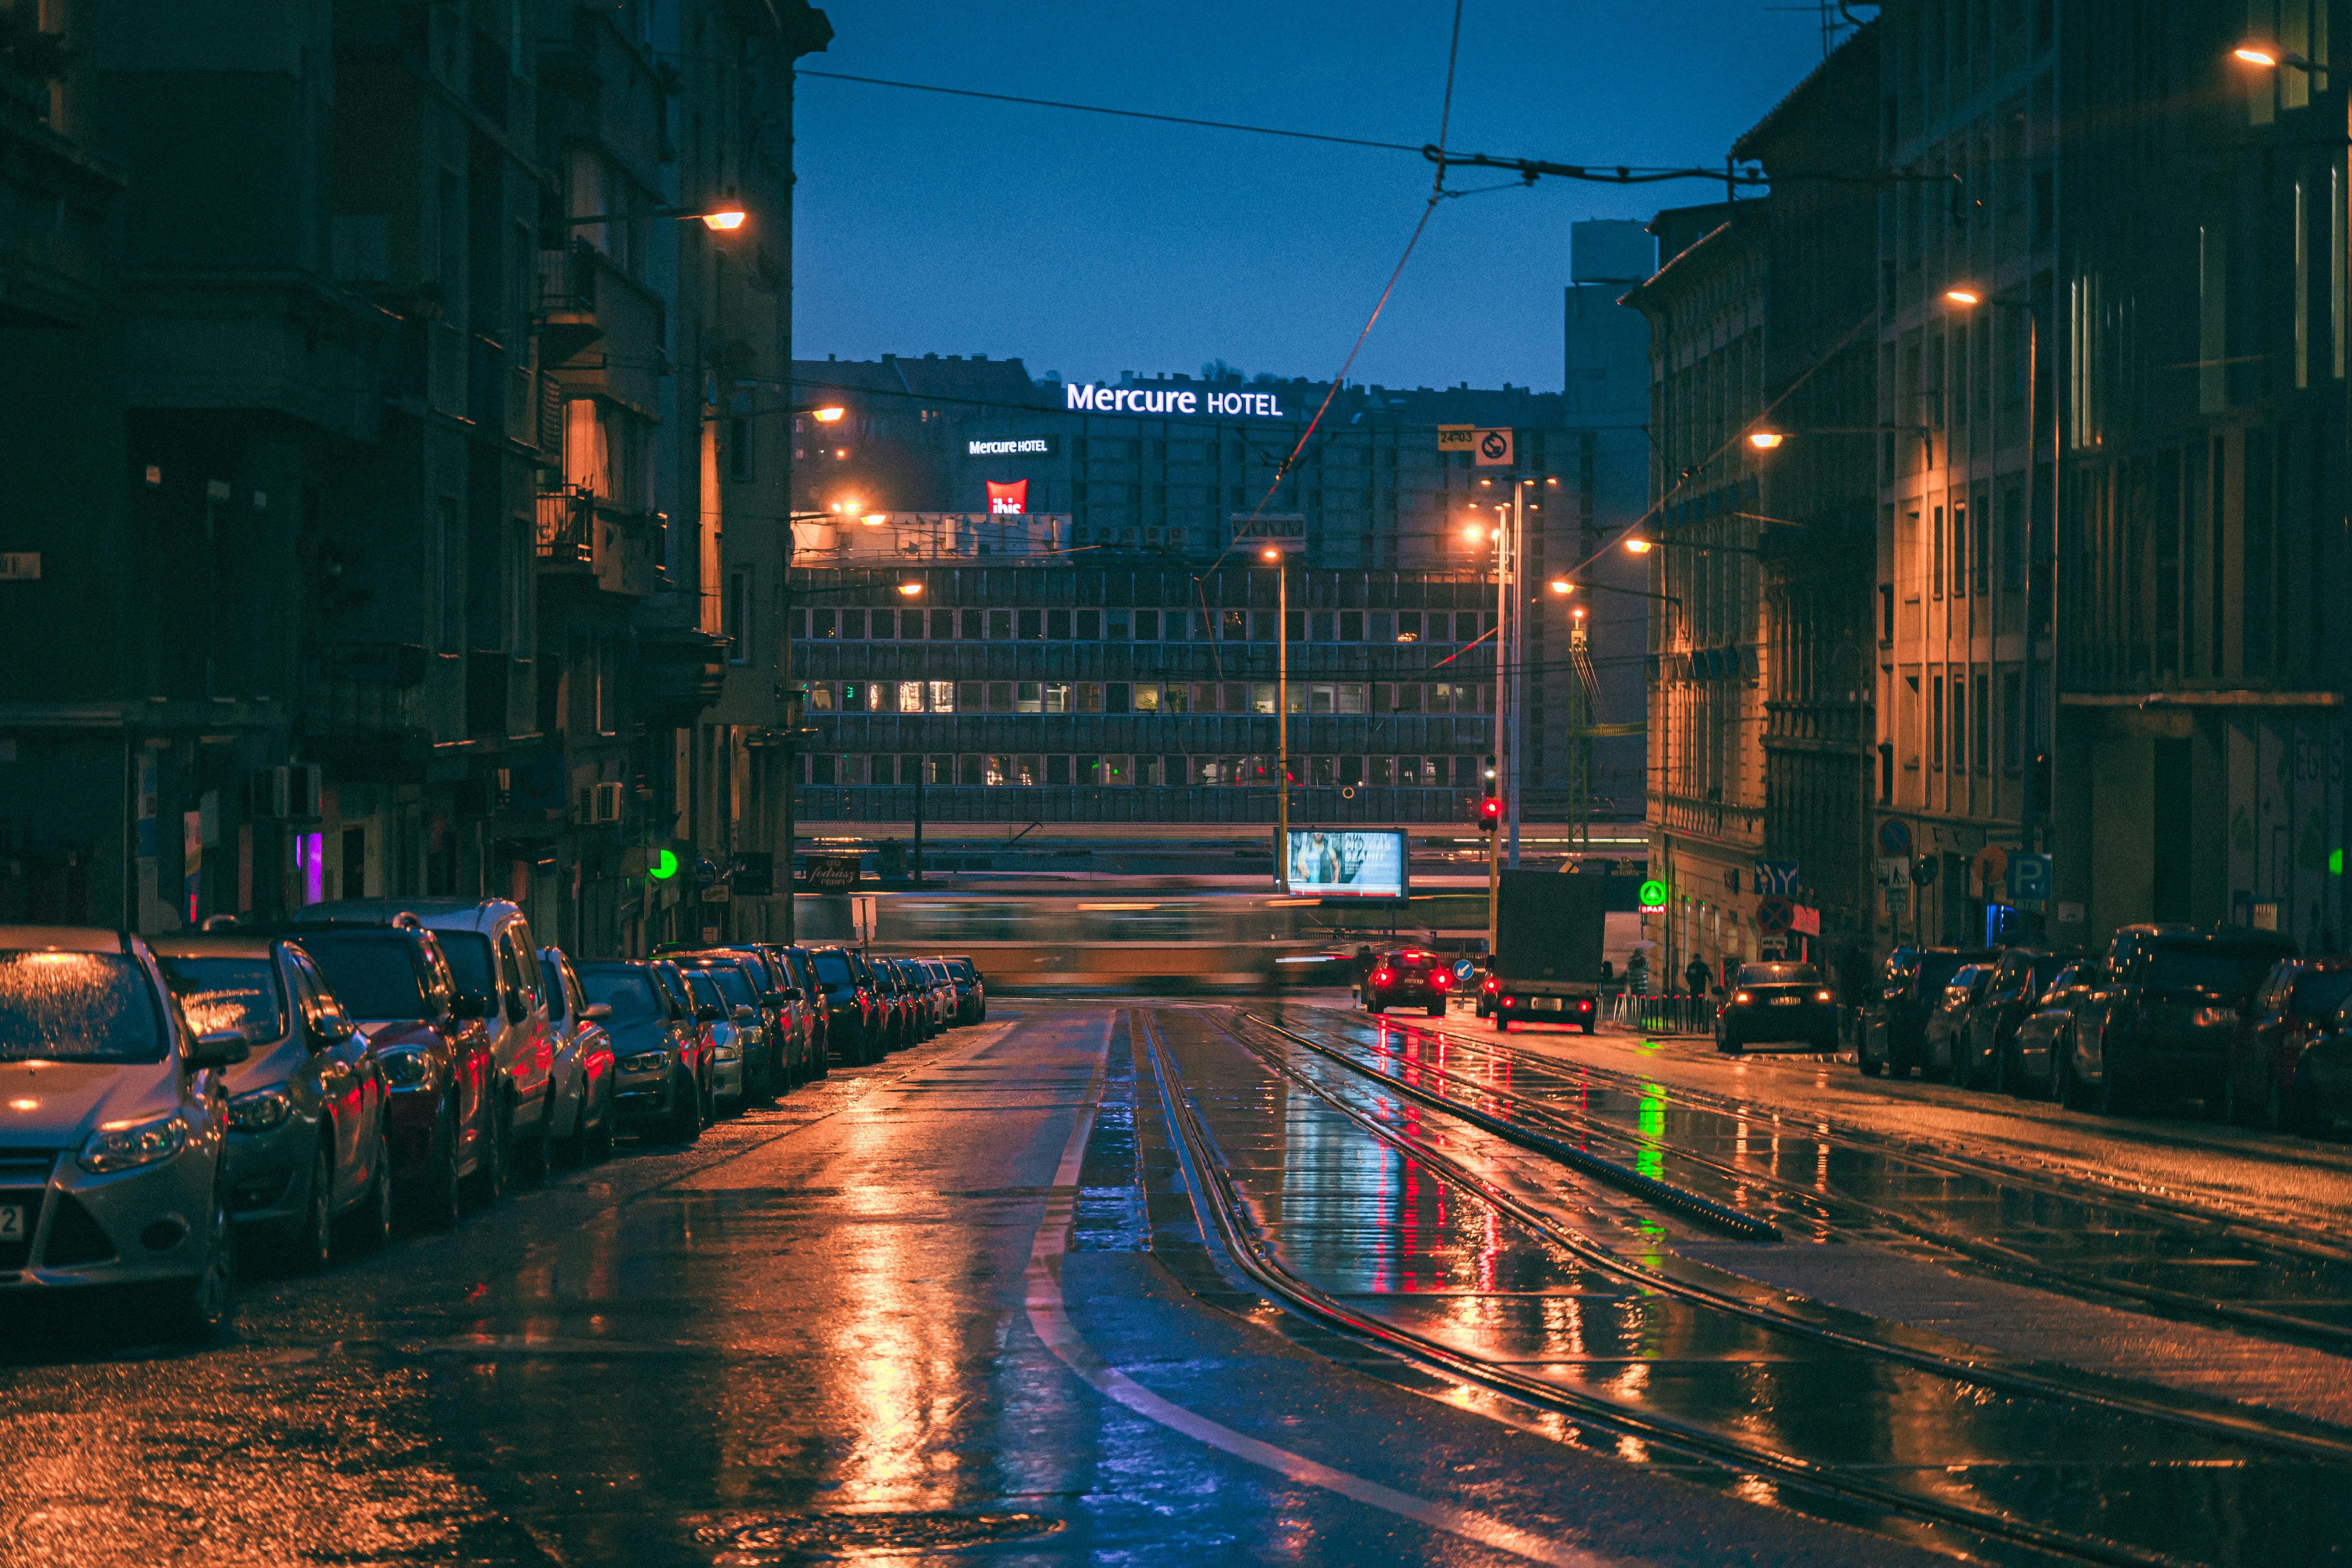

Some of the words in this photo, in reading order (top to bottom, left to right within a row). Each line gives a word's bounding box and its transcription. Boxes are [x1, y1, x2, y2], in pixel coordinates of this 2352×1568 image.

[1068, 384, 1196, 413] Mercure
[1208, 393, 1283, 416] HOTEL
[969, 441, 1017, 454] Mercure
[1018, 440, 1048, 452] HOTEL
[993, 497, 1021, 514] ibis
[808, 866, 856, 884] fodrász
[2015, 860, 2042, 894] P
